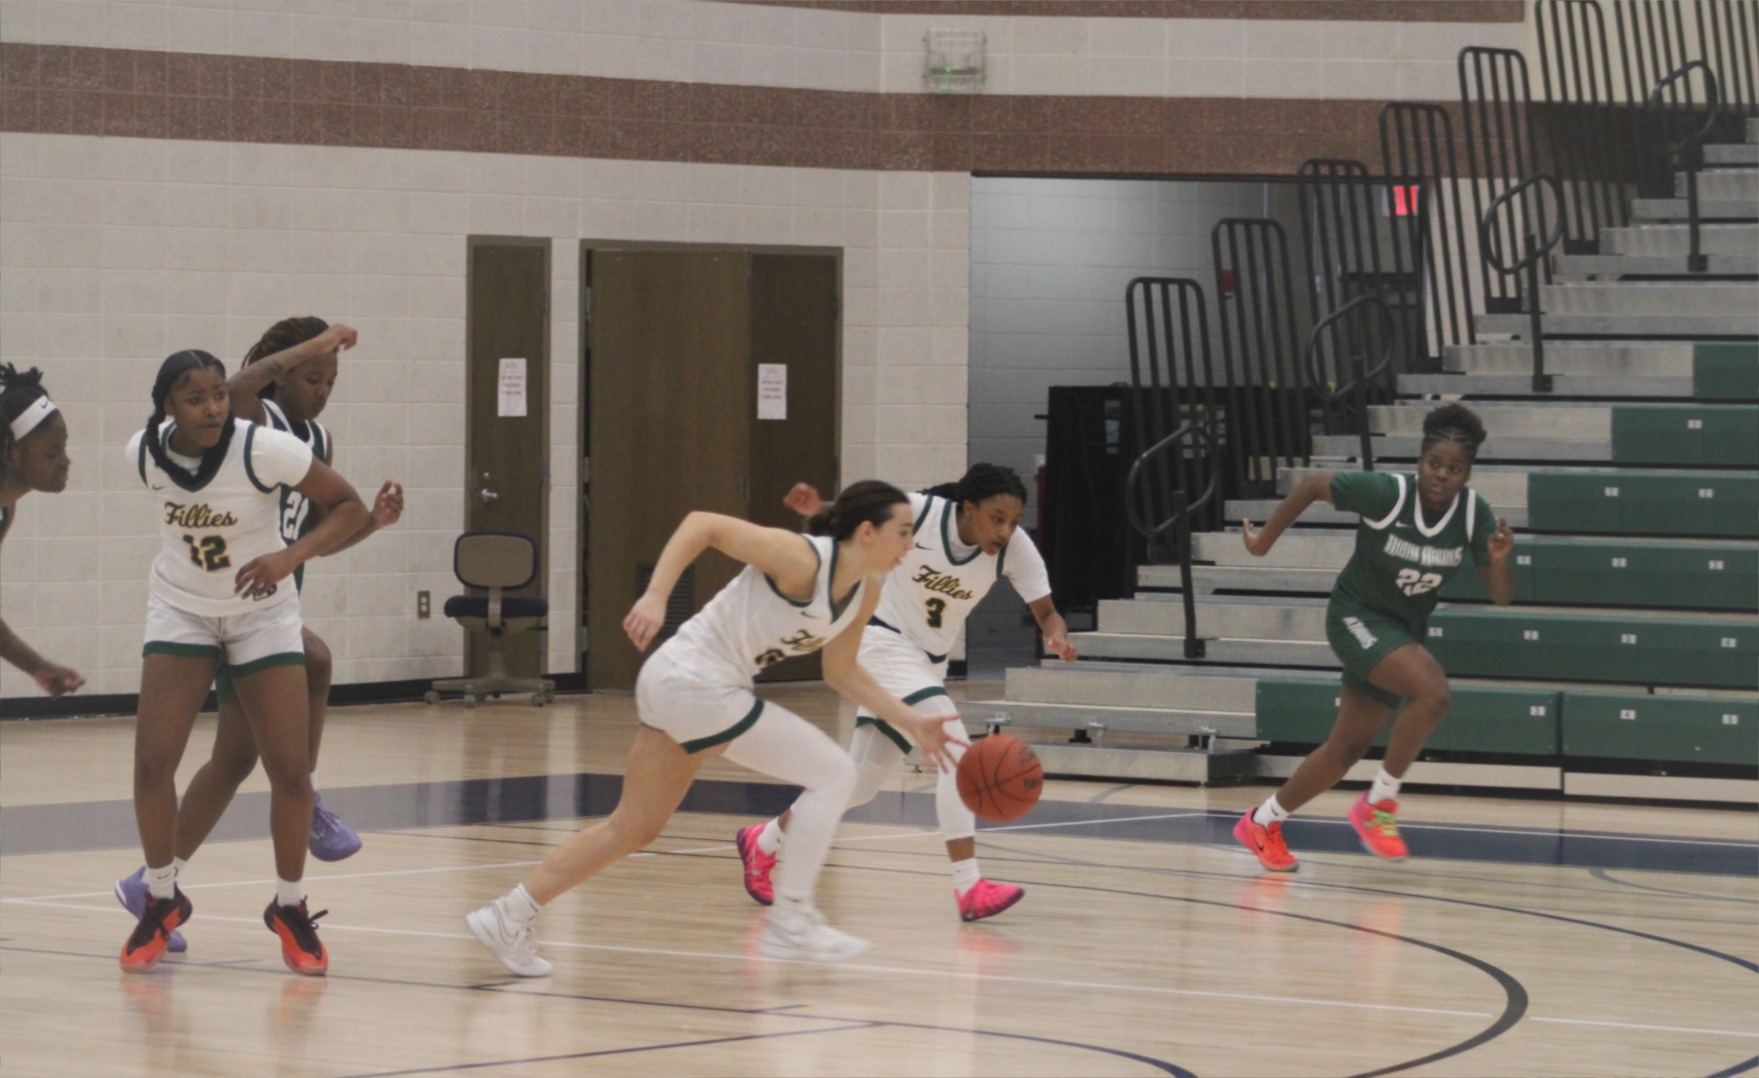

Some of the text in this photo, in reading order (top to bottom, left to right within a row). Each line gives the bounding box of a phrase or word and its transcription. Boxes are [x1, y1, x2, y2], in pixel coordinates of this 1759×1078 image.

[164, 501, 238, 528] Fillies
[282, 490, 309, 540] 21
[182, 534, 231, 571] 12
[912, 564, 974, 600] Fillies
[1395, 568, 1443, 596] 22
[925, 597, 946, 629] 3
